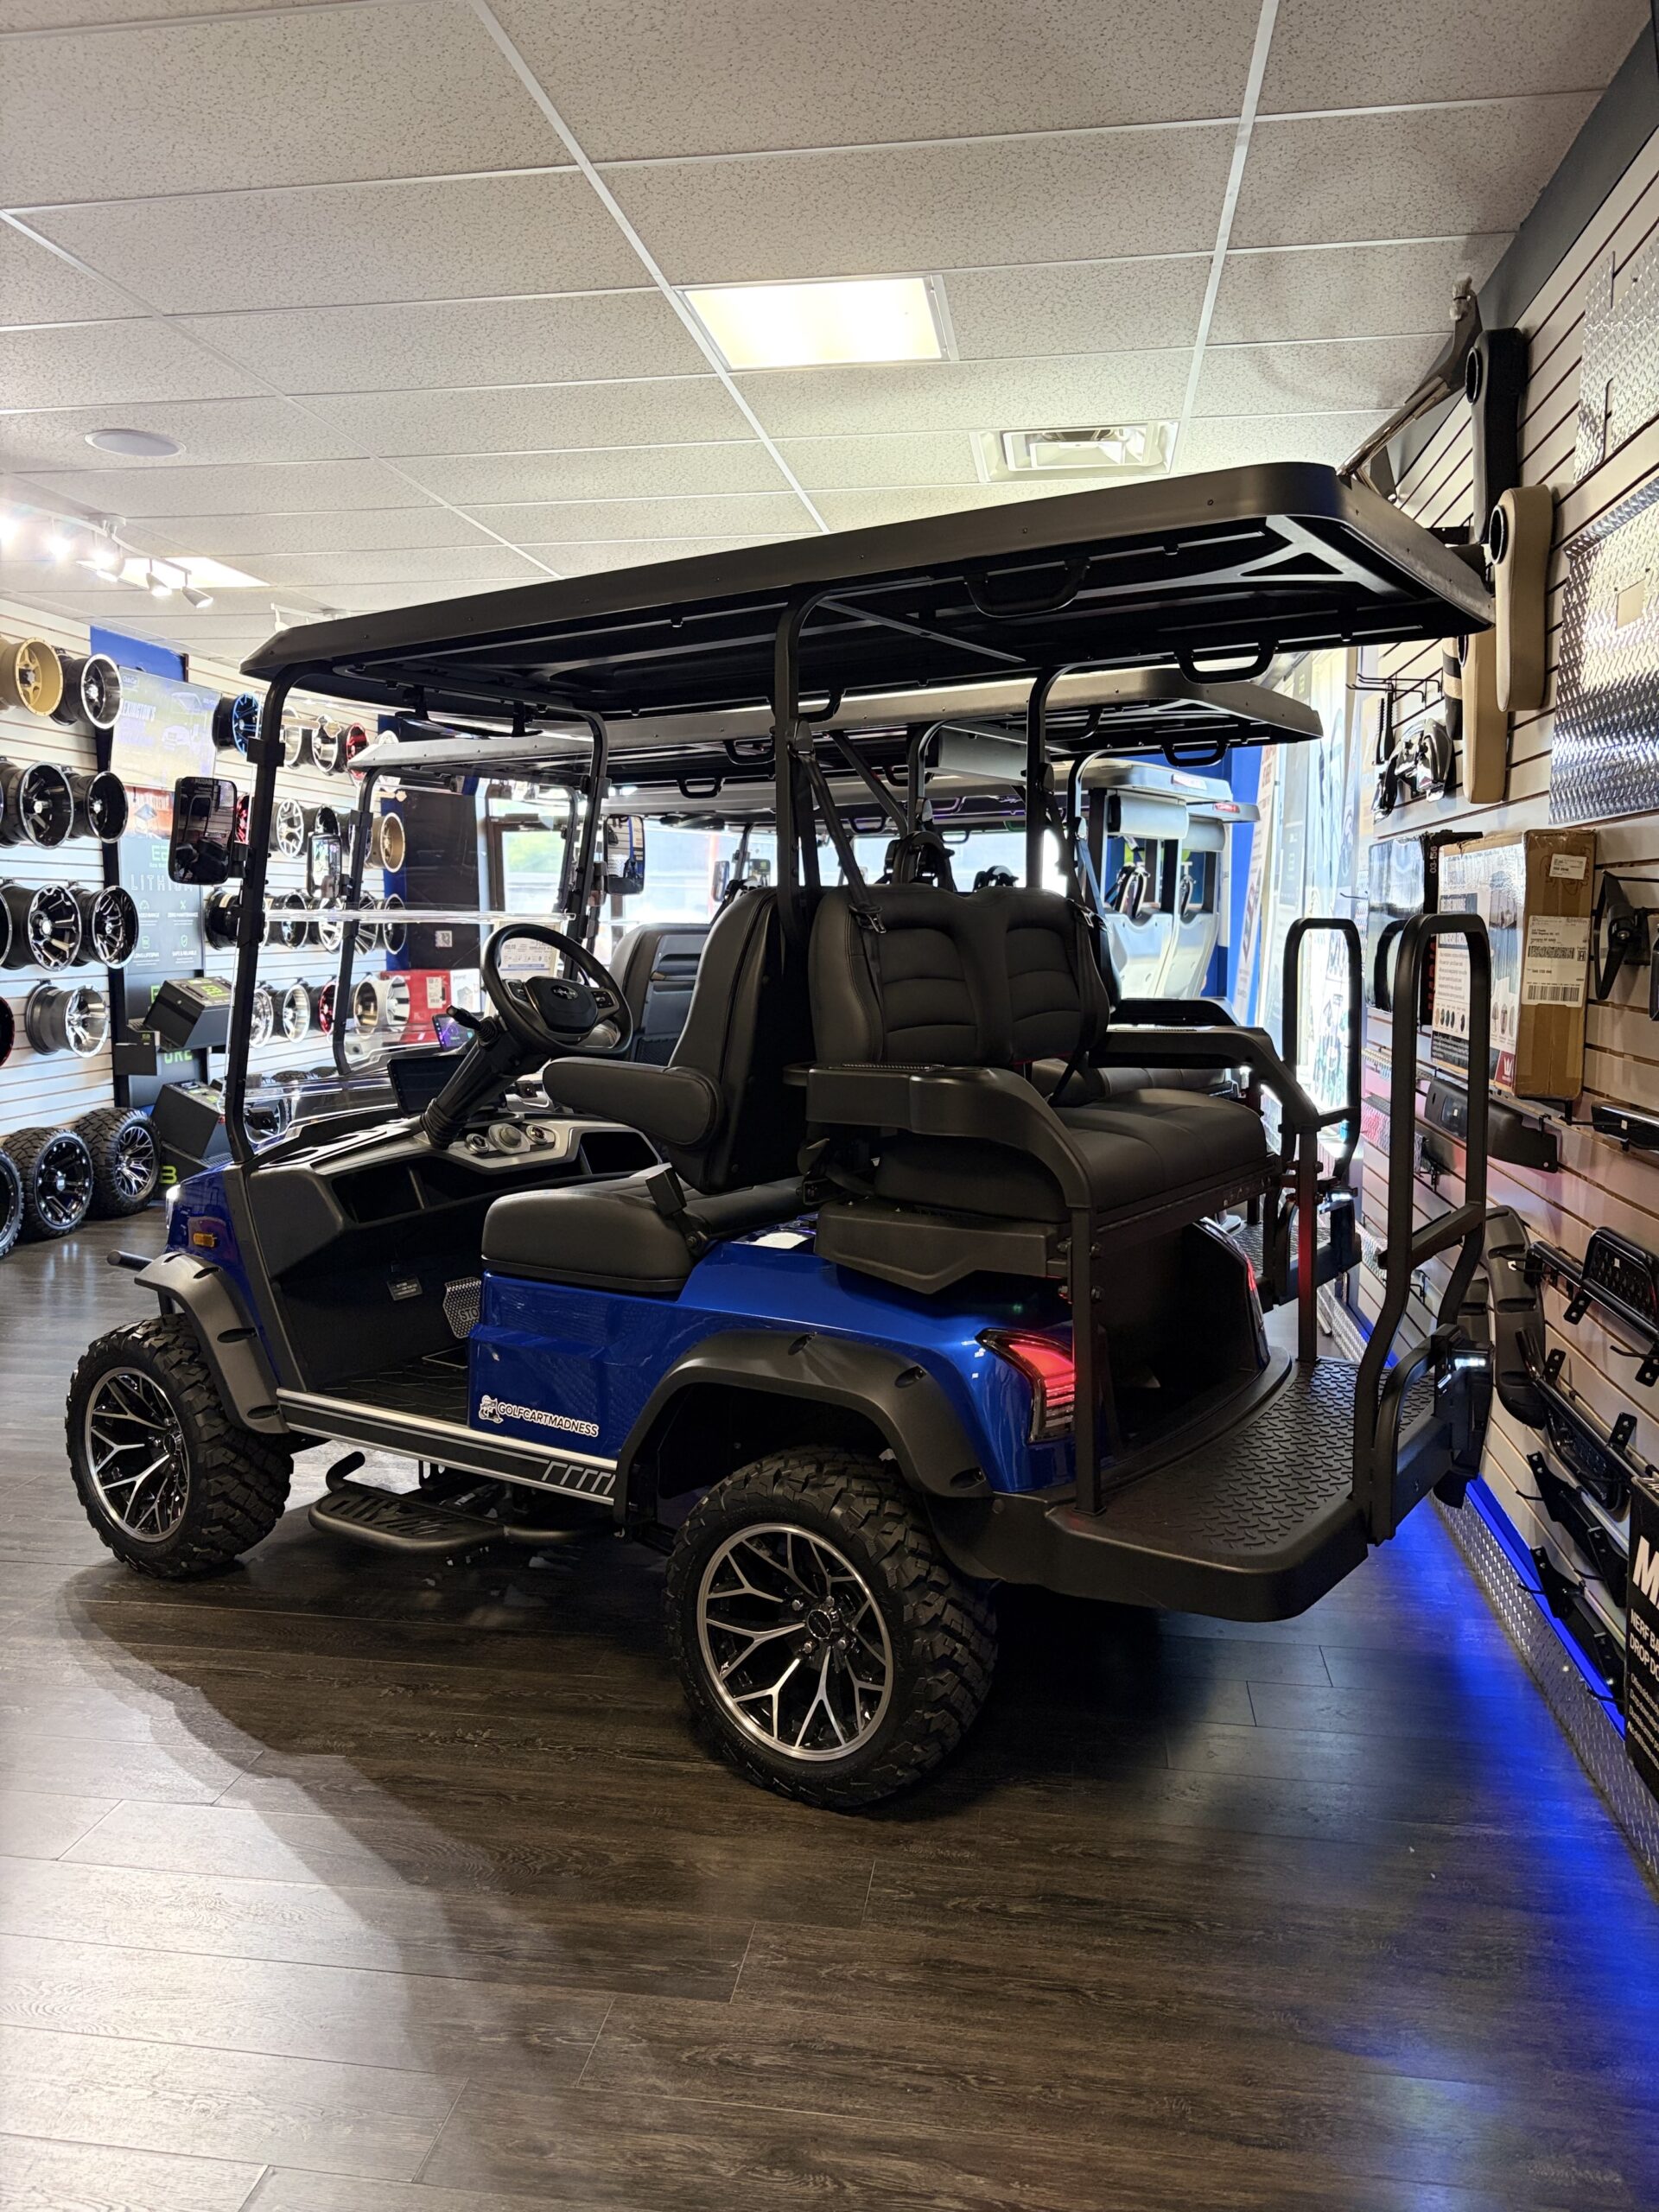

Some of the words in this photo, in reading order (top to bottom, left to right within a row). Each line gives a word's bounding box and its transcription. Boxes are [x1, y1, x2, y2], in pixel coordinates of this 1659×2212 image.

[460, 1307, 479, 1320] STO
[499, 1402, 598, 1436] GOLFCARTMADNESS
[1632, 1535, 1659, 1607] M
[1630, 1608, 1650, 1641] NERF
[1630, 1632, 1650, 1667] DROP
